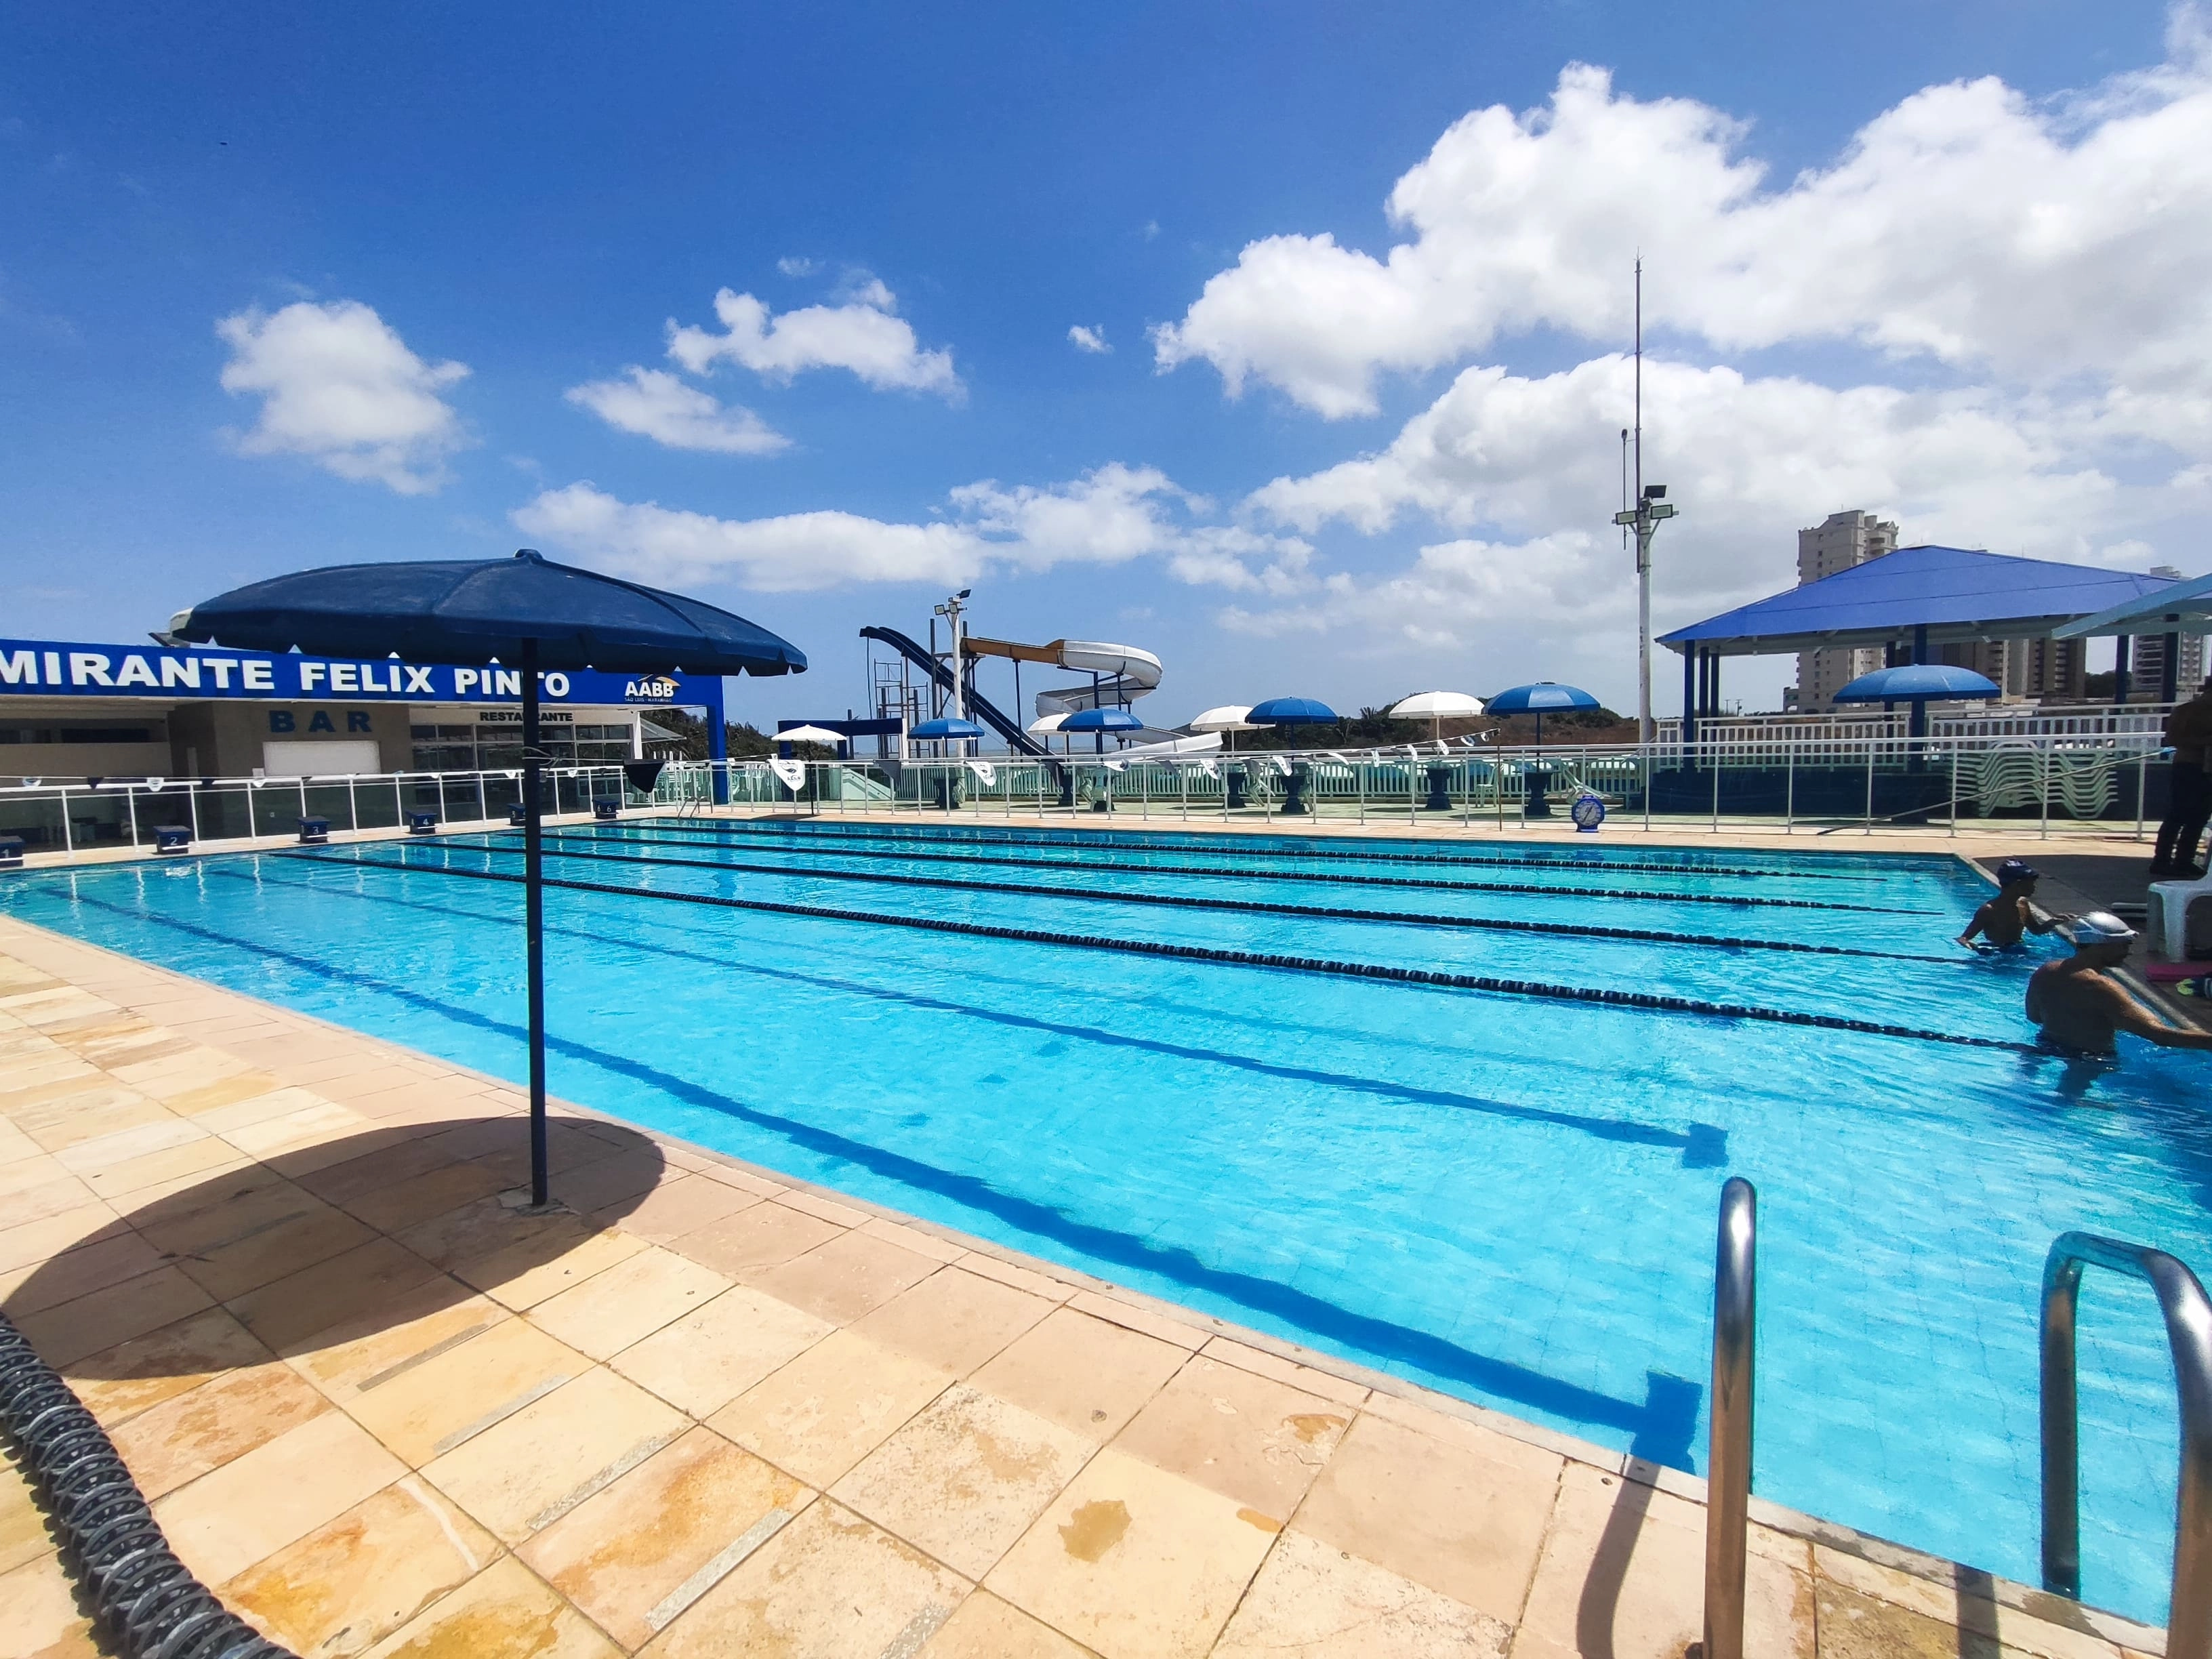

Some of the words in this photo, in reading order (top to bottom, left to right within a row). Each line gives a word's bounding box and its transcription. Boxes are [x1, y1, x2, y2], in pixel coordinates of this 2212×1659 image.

[0, 650, 274, 690] MIRANTE
[299, 662, 435, 693] FELIX
[625, 681, 674, 697] AABB
[268, 710, 372, 733] BAR
[480, 712, 573, 722] RESTAANTE
[312, 826, 319, 835] 3
[169, 836, 178, 846] 2
[1, 848, 10, 859] 1
